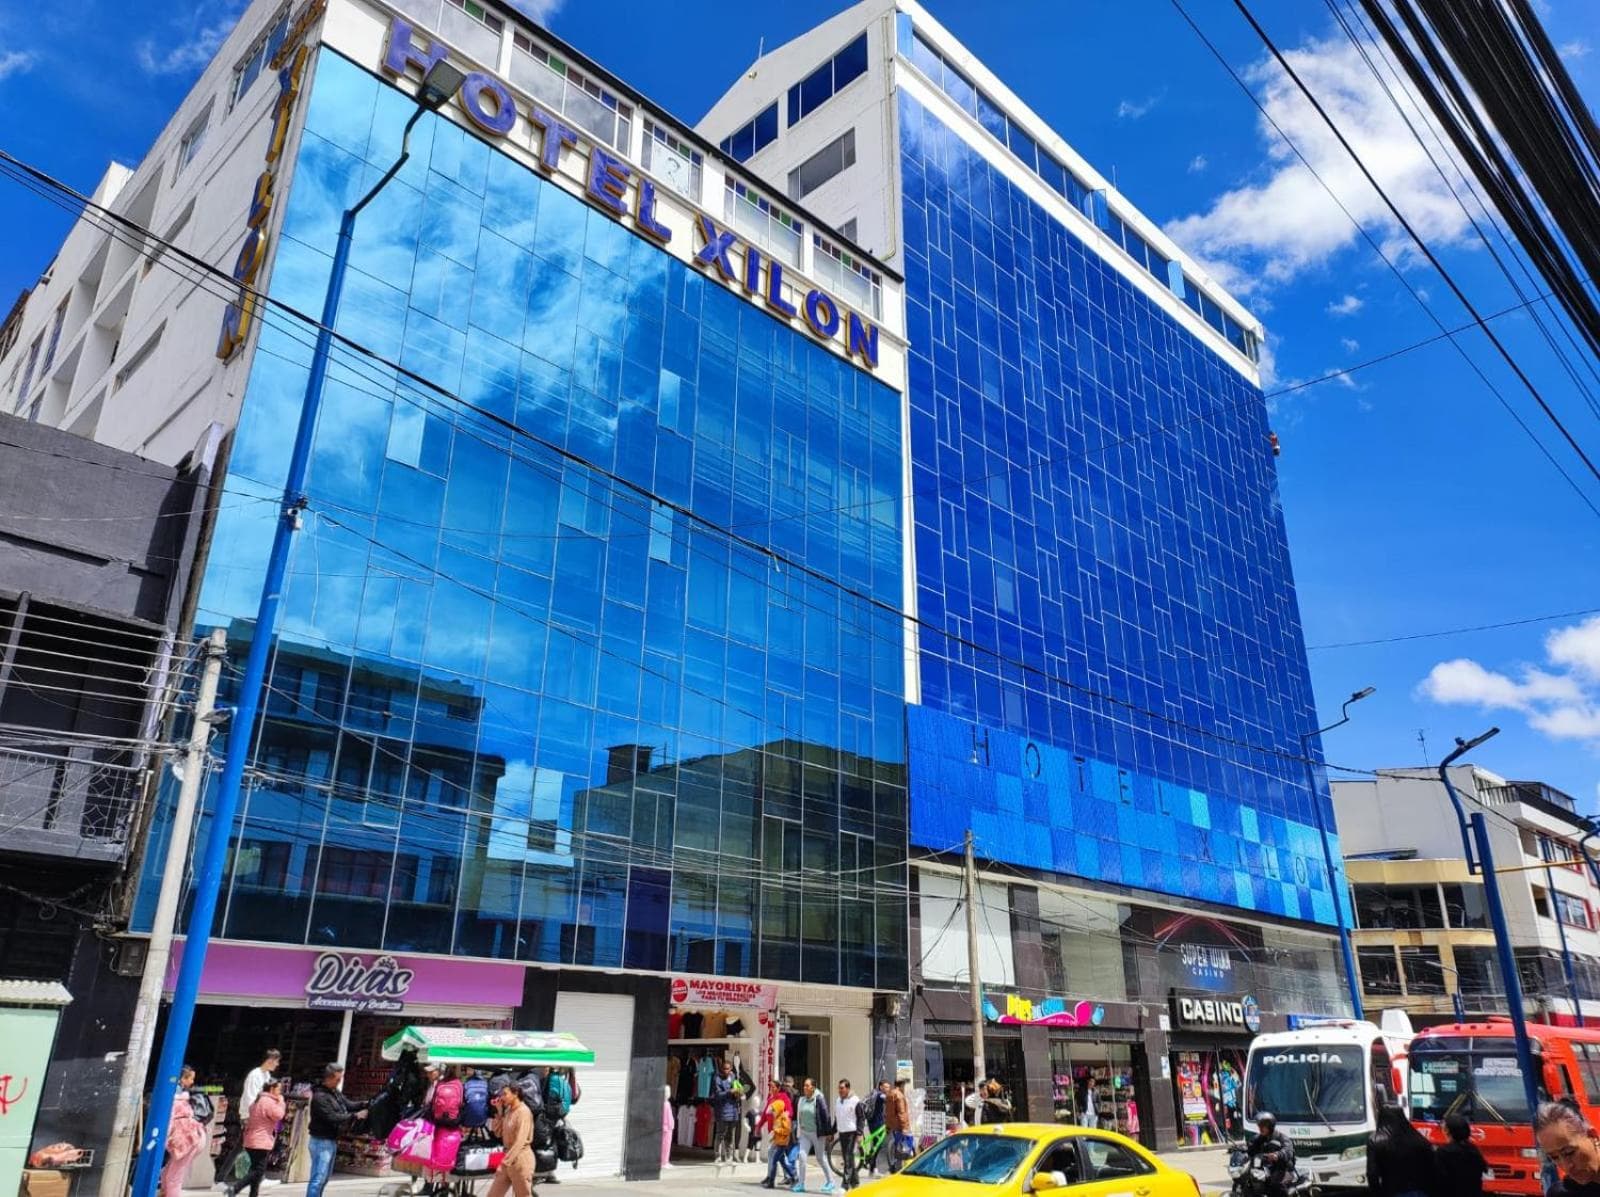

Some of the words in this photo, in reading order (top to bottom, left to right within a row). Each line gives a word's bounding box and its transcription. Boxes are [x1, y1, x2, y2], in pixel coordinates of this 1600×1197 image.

[380, 16, 672, 244] HOTEL
[692, 211, 880, 369] XILON
[971, 724, 1171, 817] HOTEL
[1180, 944, 1209, 967] SUPER
[306, 953, 413, 996] Divas
[1192, 967, 1225, 978] CASINO
[689, 979, 762, 994] MAYORISTAS
[1180, 998, 1244, 1024] CASINO
[1263, 1053, 1342, 1065] POLICÍA
